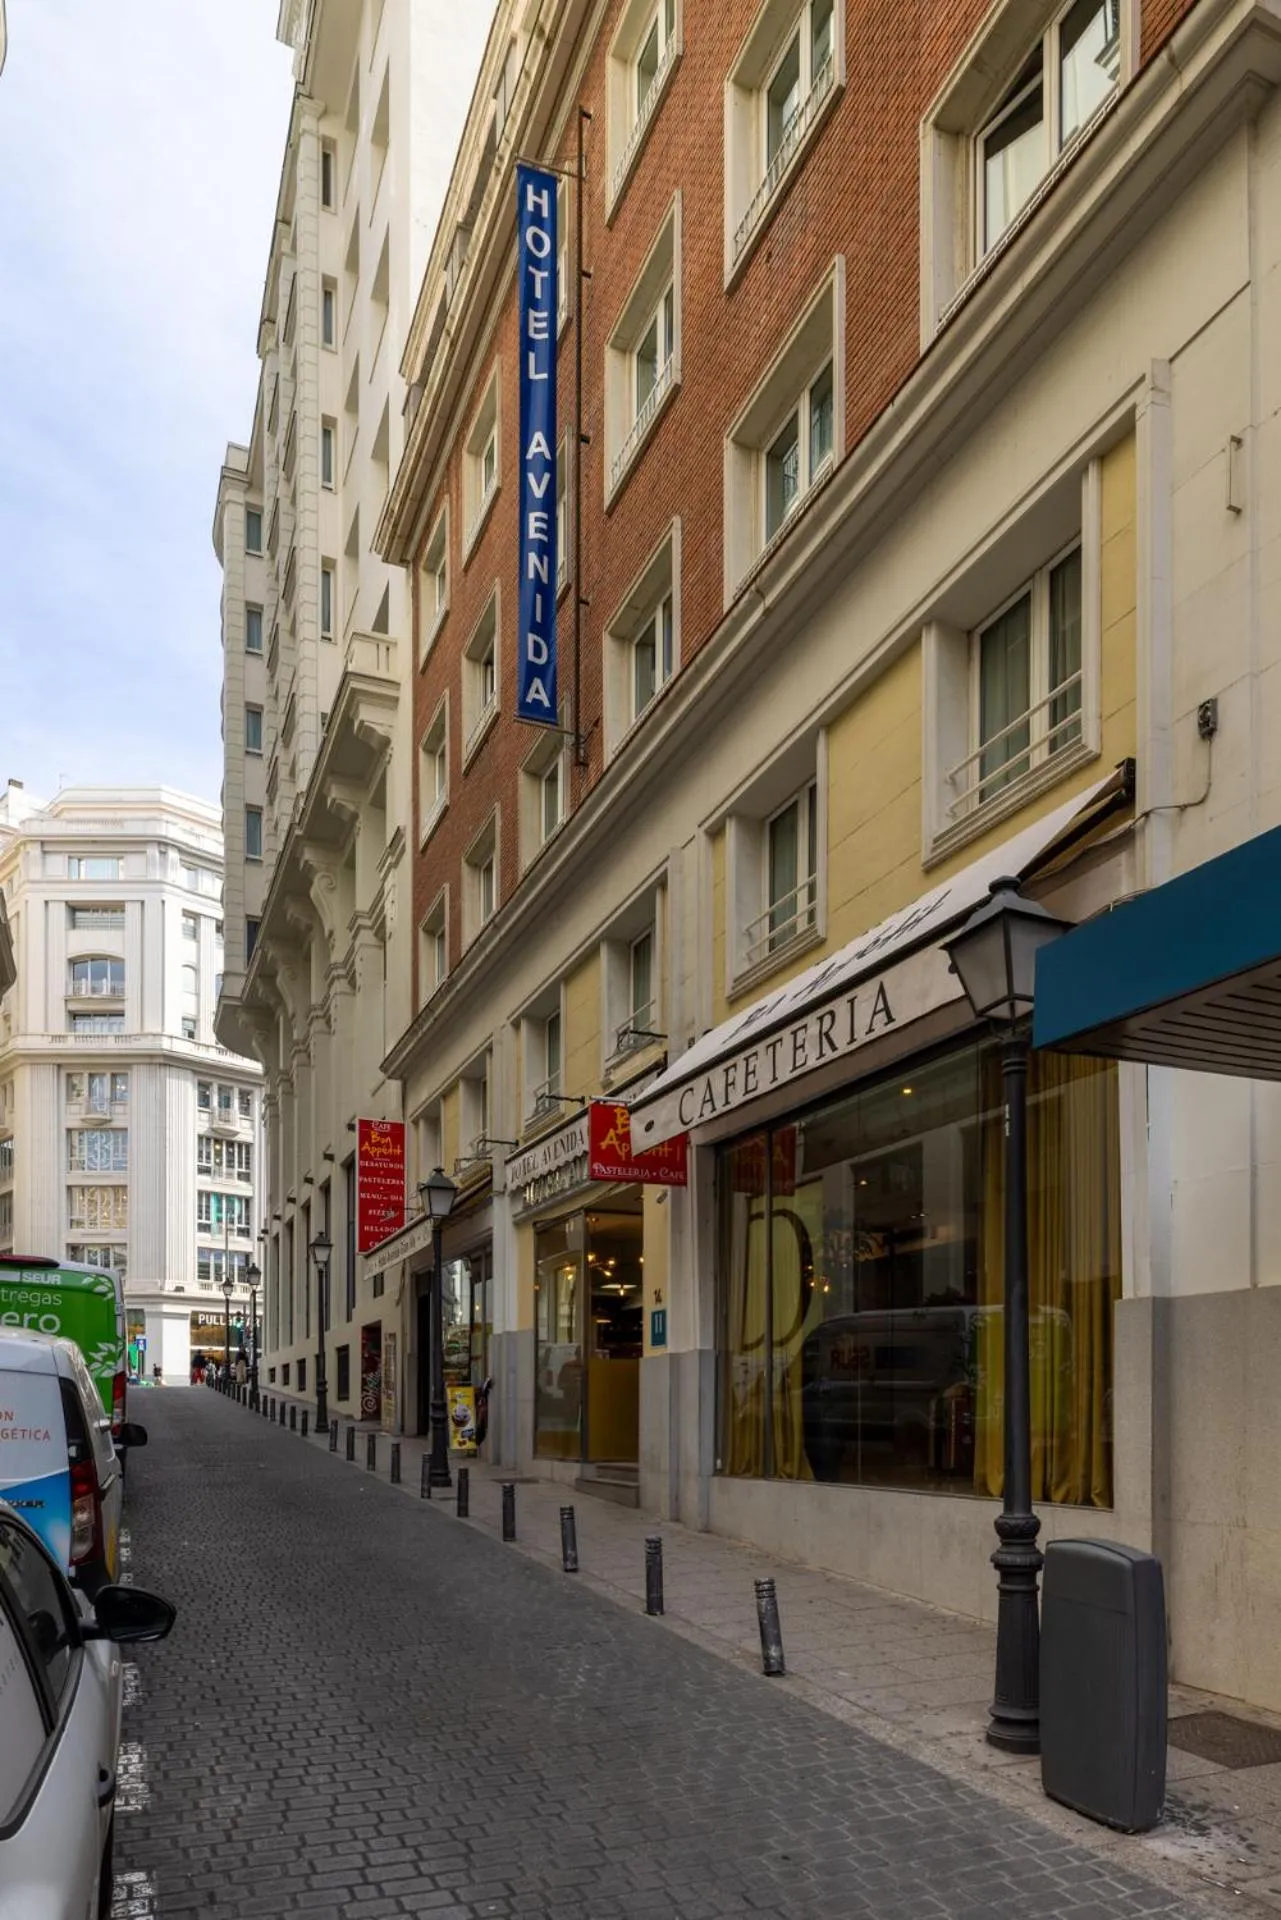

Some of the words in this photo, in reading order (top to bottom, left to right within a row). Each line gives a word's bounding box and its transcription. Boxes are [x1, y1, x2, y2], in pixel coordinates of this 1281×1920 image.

[525, 182, 551, 381] HOTEL
[524, 430, 553, 709] AVENIDA
[678, 980, 897, 1127] CAFETERIA
[0, 1287, 62, 1307] tregas
[22, 1271, 61, 1285] SEUR
[1, 1311, 61, 1334] ero
